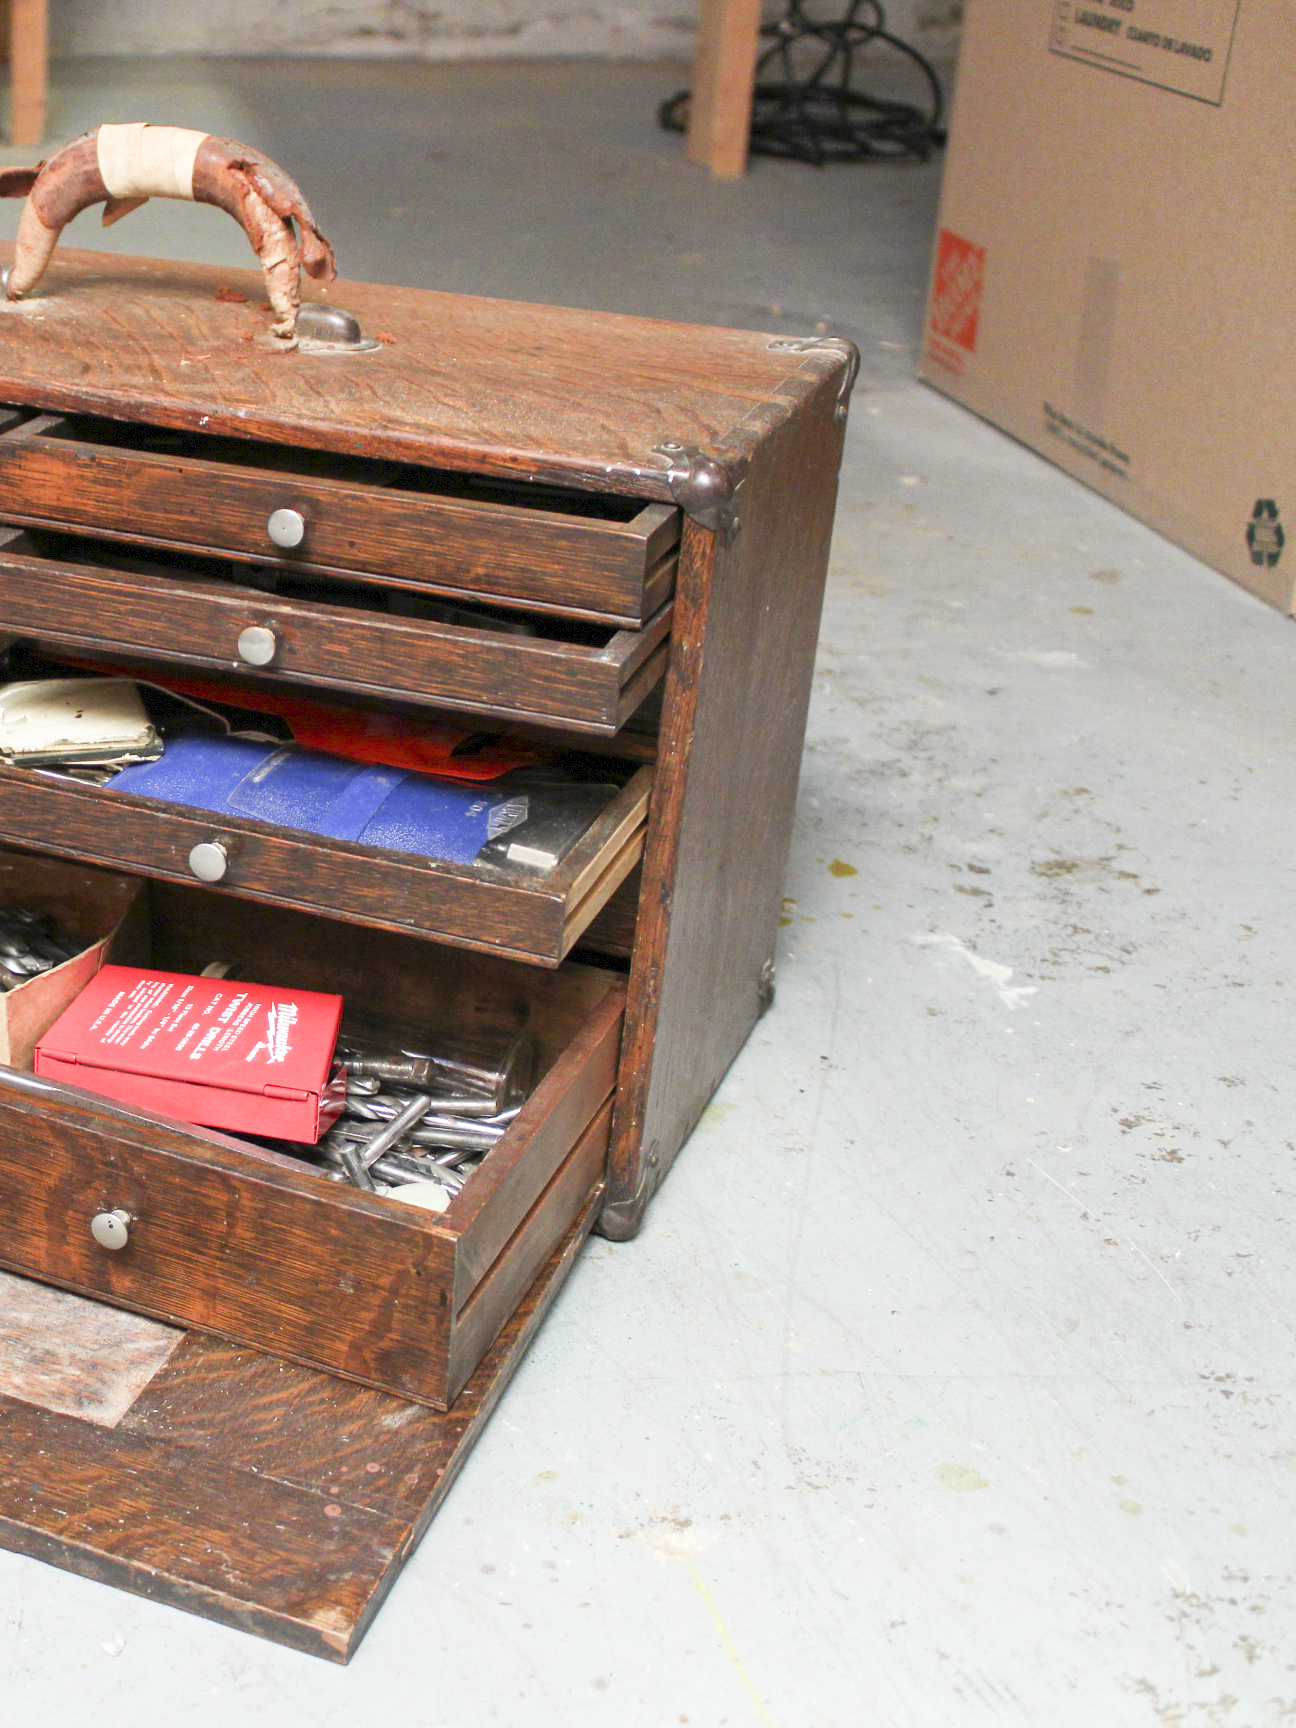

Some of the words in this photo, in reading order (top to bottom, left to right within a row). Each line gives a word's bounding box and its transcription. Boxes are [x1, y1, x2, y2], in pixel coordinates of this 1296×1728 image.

[107, 991, 125, 1007] MADE
[180, 985, 194, 997] Sizes
[209, 993, 223, 1005] CAT
[201, 1005, 214, 1015] NO.
[215, 991, 248, 1023] TWIST
[231, 1002, 254, 1026] JOBBERS
[246, 1003, 261, 1017] HIGH
[173, 1010, 188, 1023] Piece
[166, 1023, 178, 1031] Set
[233, 1017, 251, 1035] SPEED
[275, 1002, 298, 1062] Milwaukee
[188, 1026, 221, 1060] DRILLS
[212, 1028, 233, 1051] LENGTH
[220, 1034, 238, 1052] STEEL
